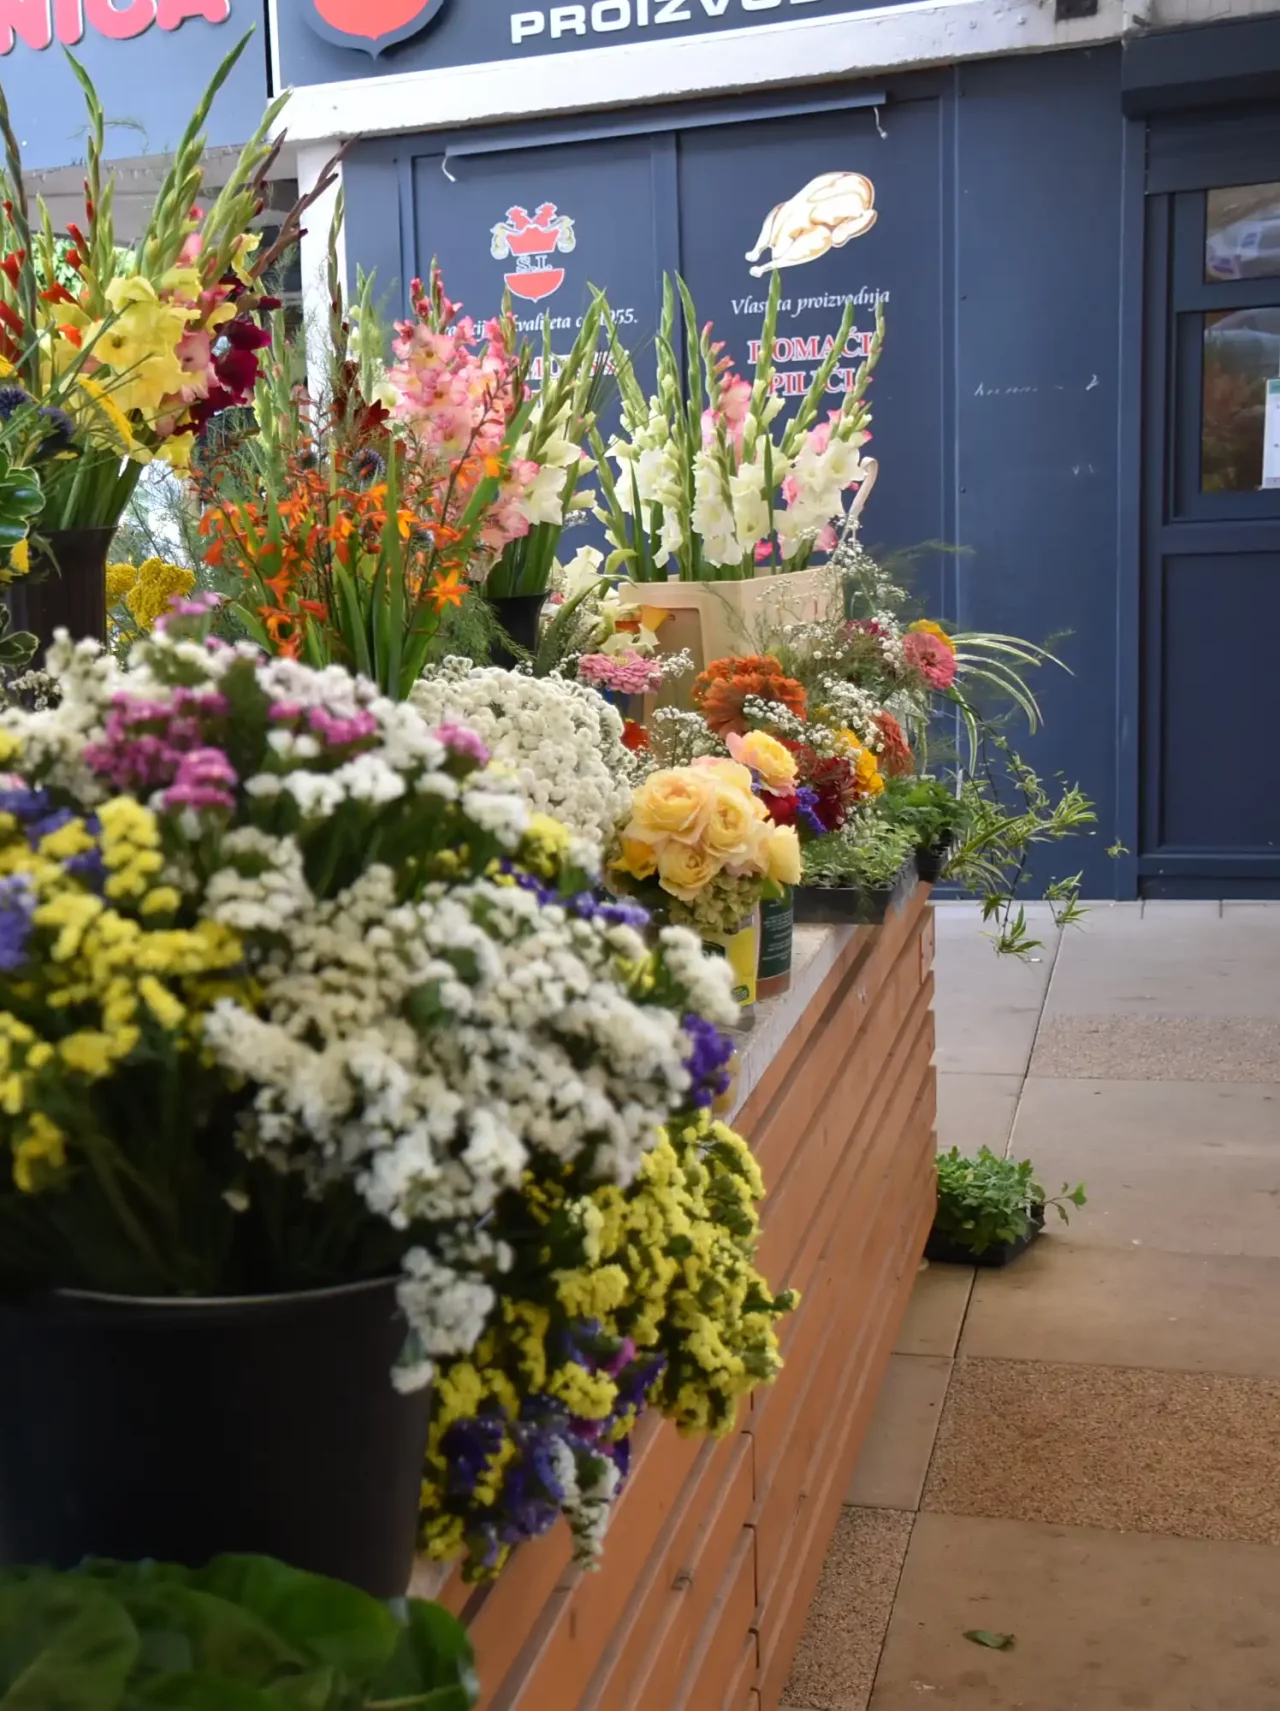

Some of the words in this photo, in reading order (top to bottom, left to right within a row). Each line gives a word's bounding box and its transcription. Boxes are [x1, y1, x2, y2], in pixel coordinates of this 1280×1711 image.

[508, 0, 827, 44] PROIZV
[790, 285, 890, 318] proizvodnja
[767, 362, 856, 396] PILĆI
